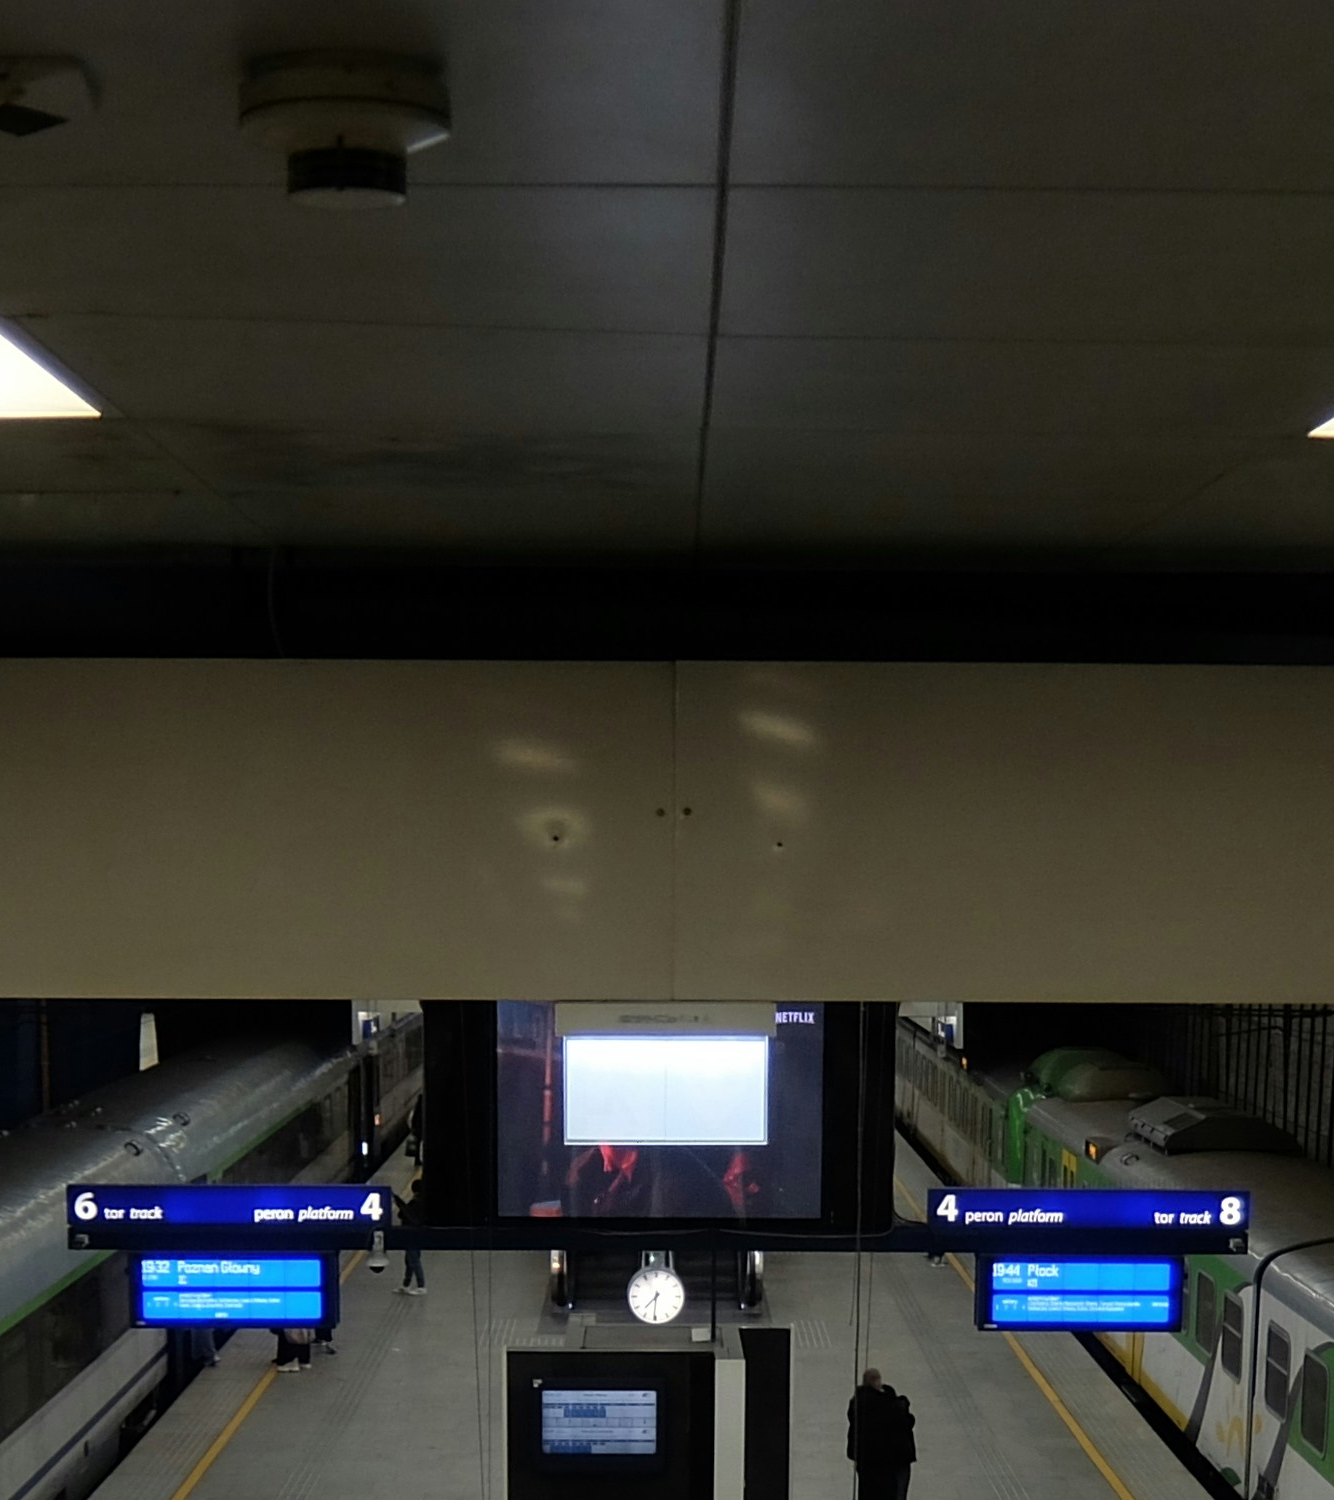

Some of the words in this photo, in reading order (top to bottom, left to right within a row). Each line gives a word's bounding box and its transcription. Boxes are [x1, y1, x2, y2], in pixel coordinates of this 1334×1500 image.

[774, 1011, 815, 1025] NETFLIX
[74, 1192, 98, 1220] 6
[104, 1207, 125, 1220] tor
[130, 1206, 163, 1220] track
[253, 1208, 294, 1223] peron
[298, 1205, 354, 1222] platform
[359, 1193, 384, 1221] 4
[936, 1194, 959, 1222] 4
[965, 1211, 1004, 1225] peron
[1008, 1209, 1064, 1225] platform
[1154, 1211, 1174, 1225] tor
[1179, 1210, 1212, 1225] track
[1219, 1197, 1242, 1225] 8
